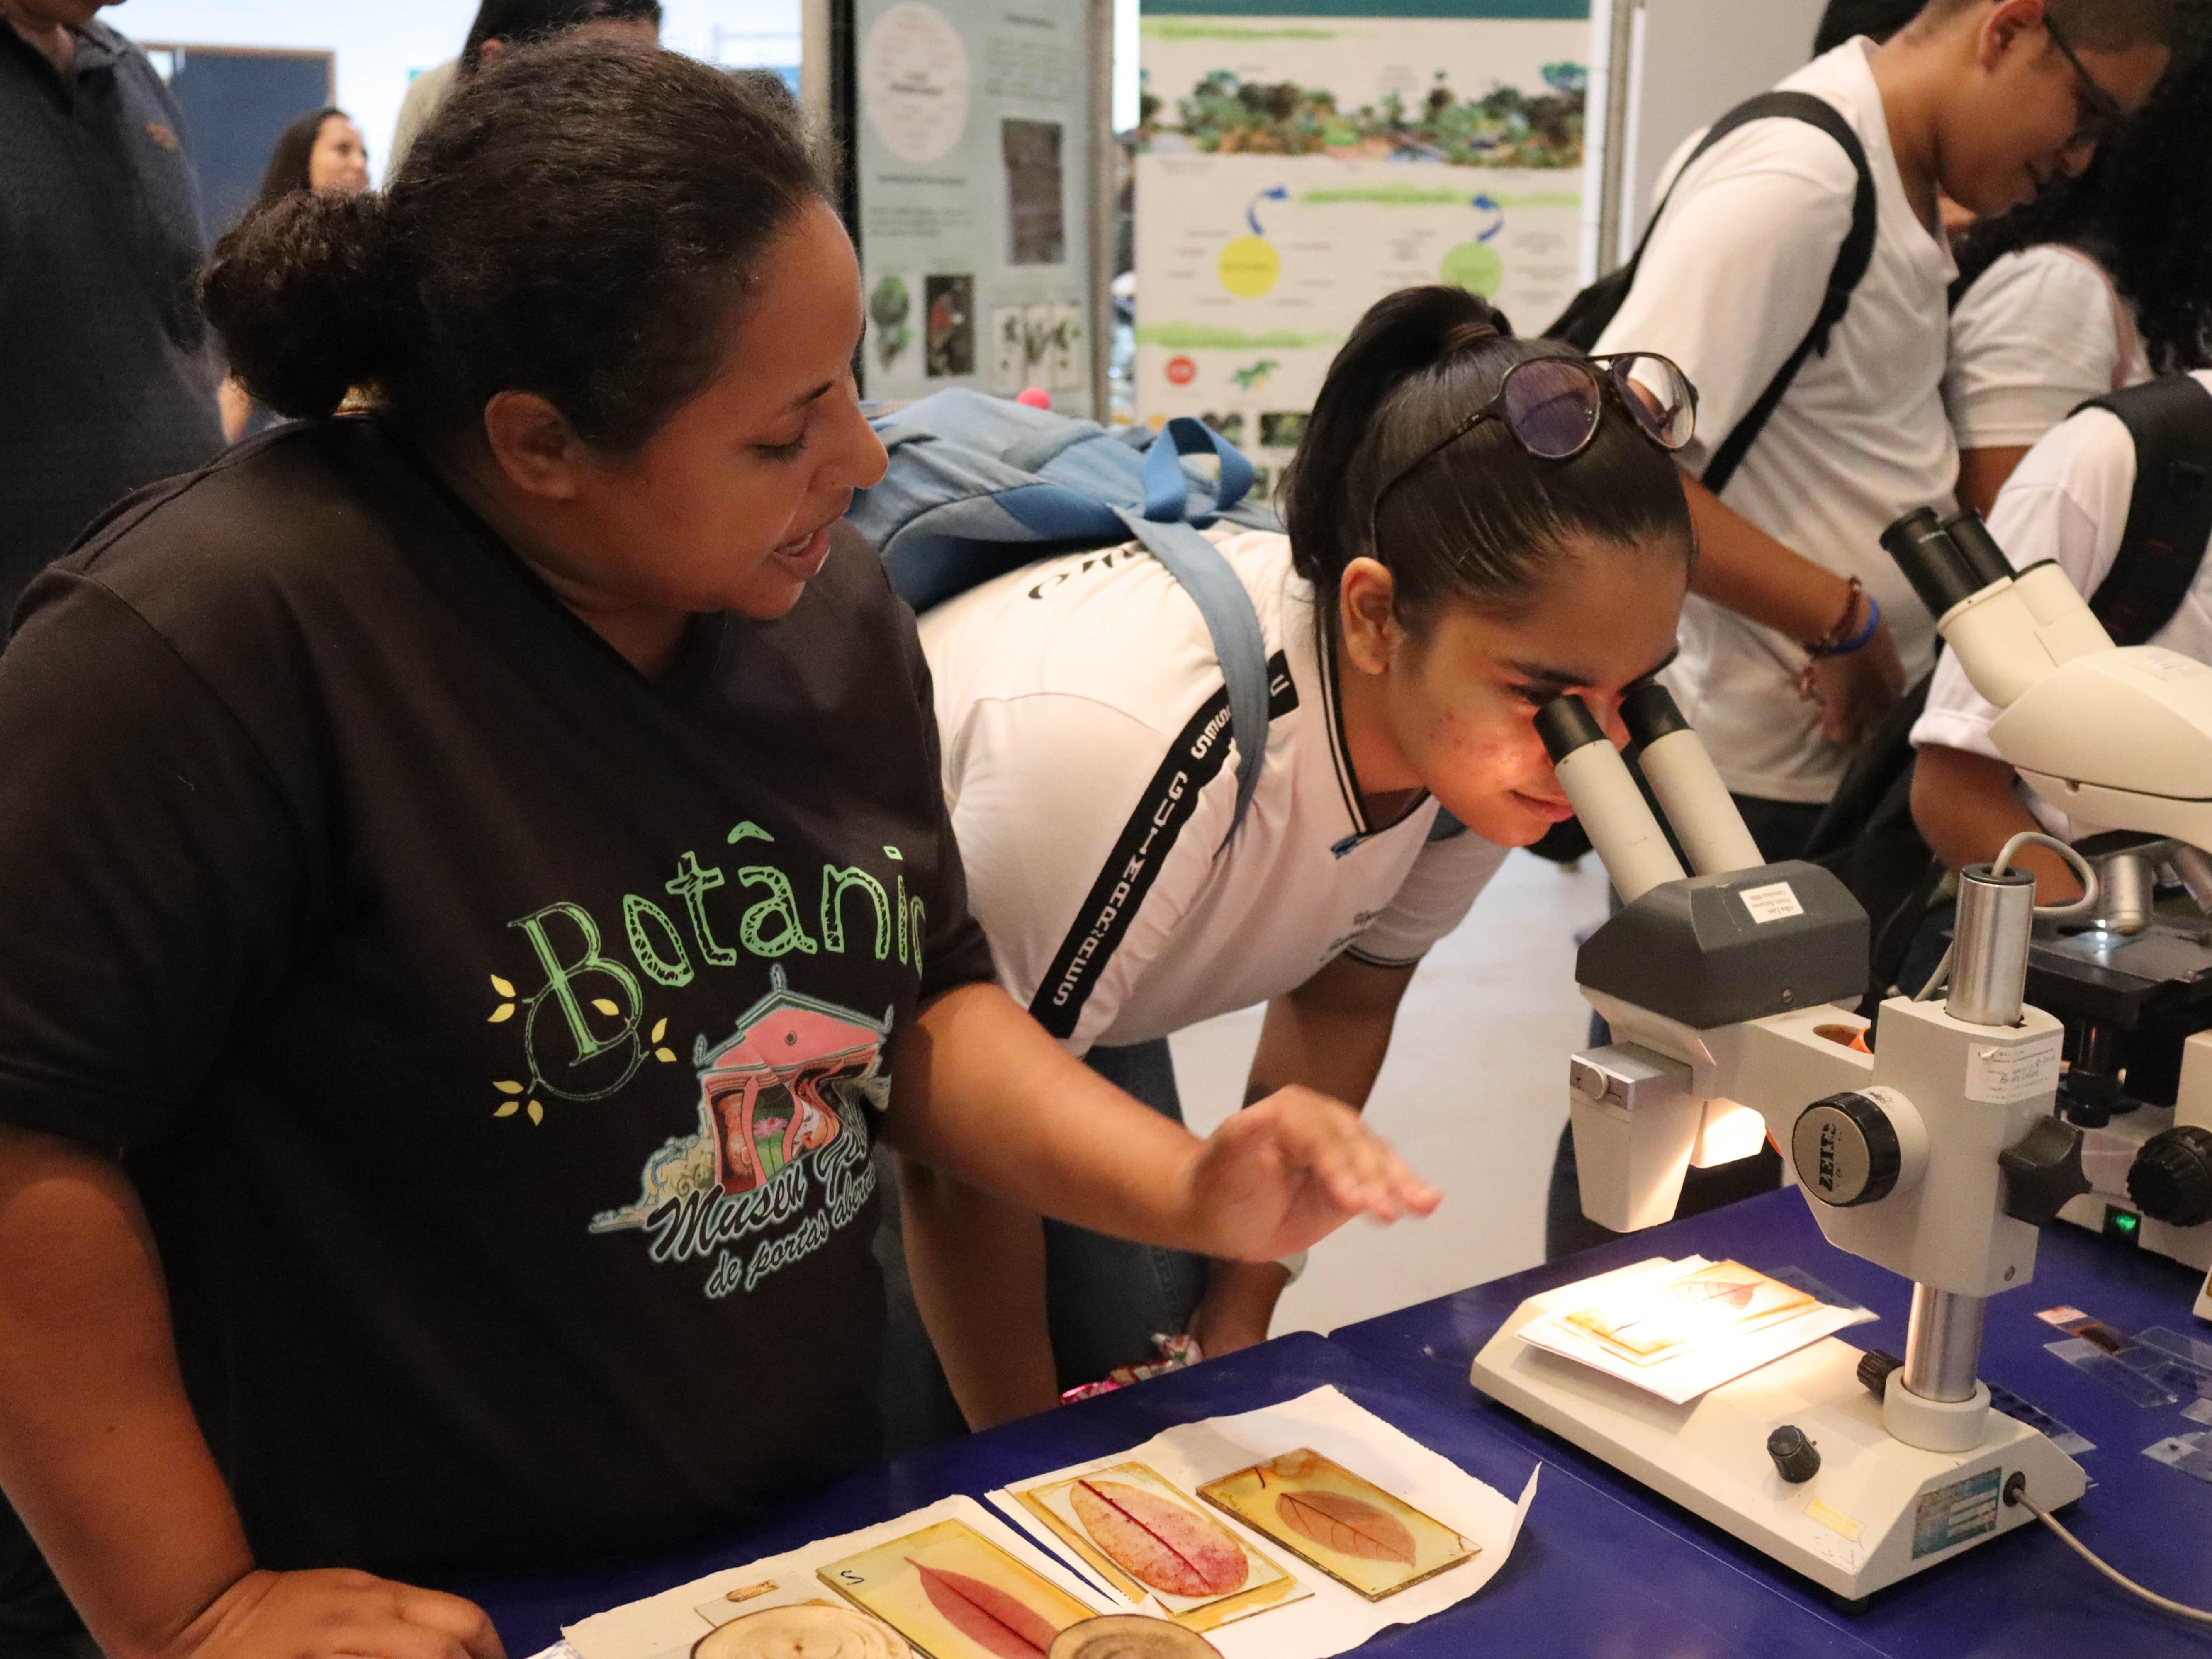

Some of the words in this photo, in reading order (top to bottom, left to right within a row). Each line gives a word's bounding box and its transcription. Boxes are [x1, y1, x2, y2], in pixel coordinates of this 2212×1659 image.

[1053, 771, 1188, 1006] GUIMARÃES
[644, 1163, 805, 1259] Museu
[708, 1252, 739, 1295] de
[748, 1213, 827, 1287] portas
